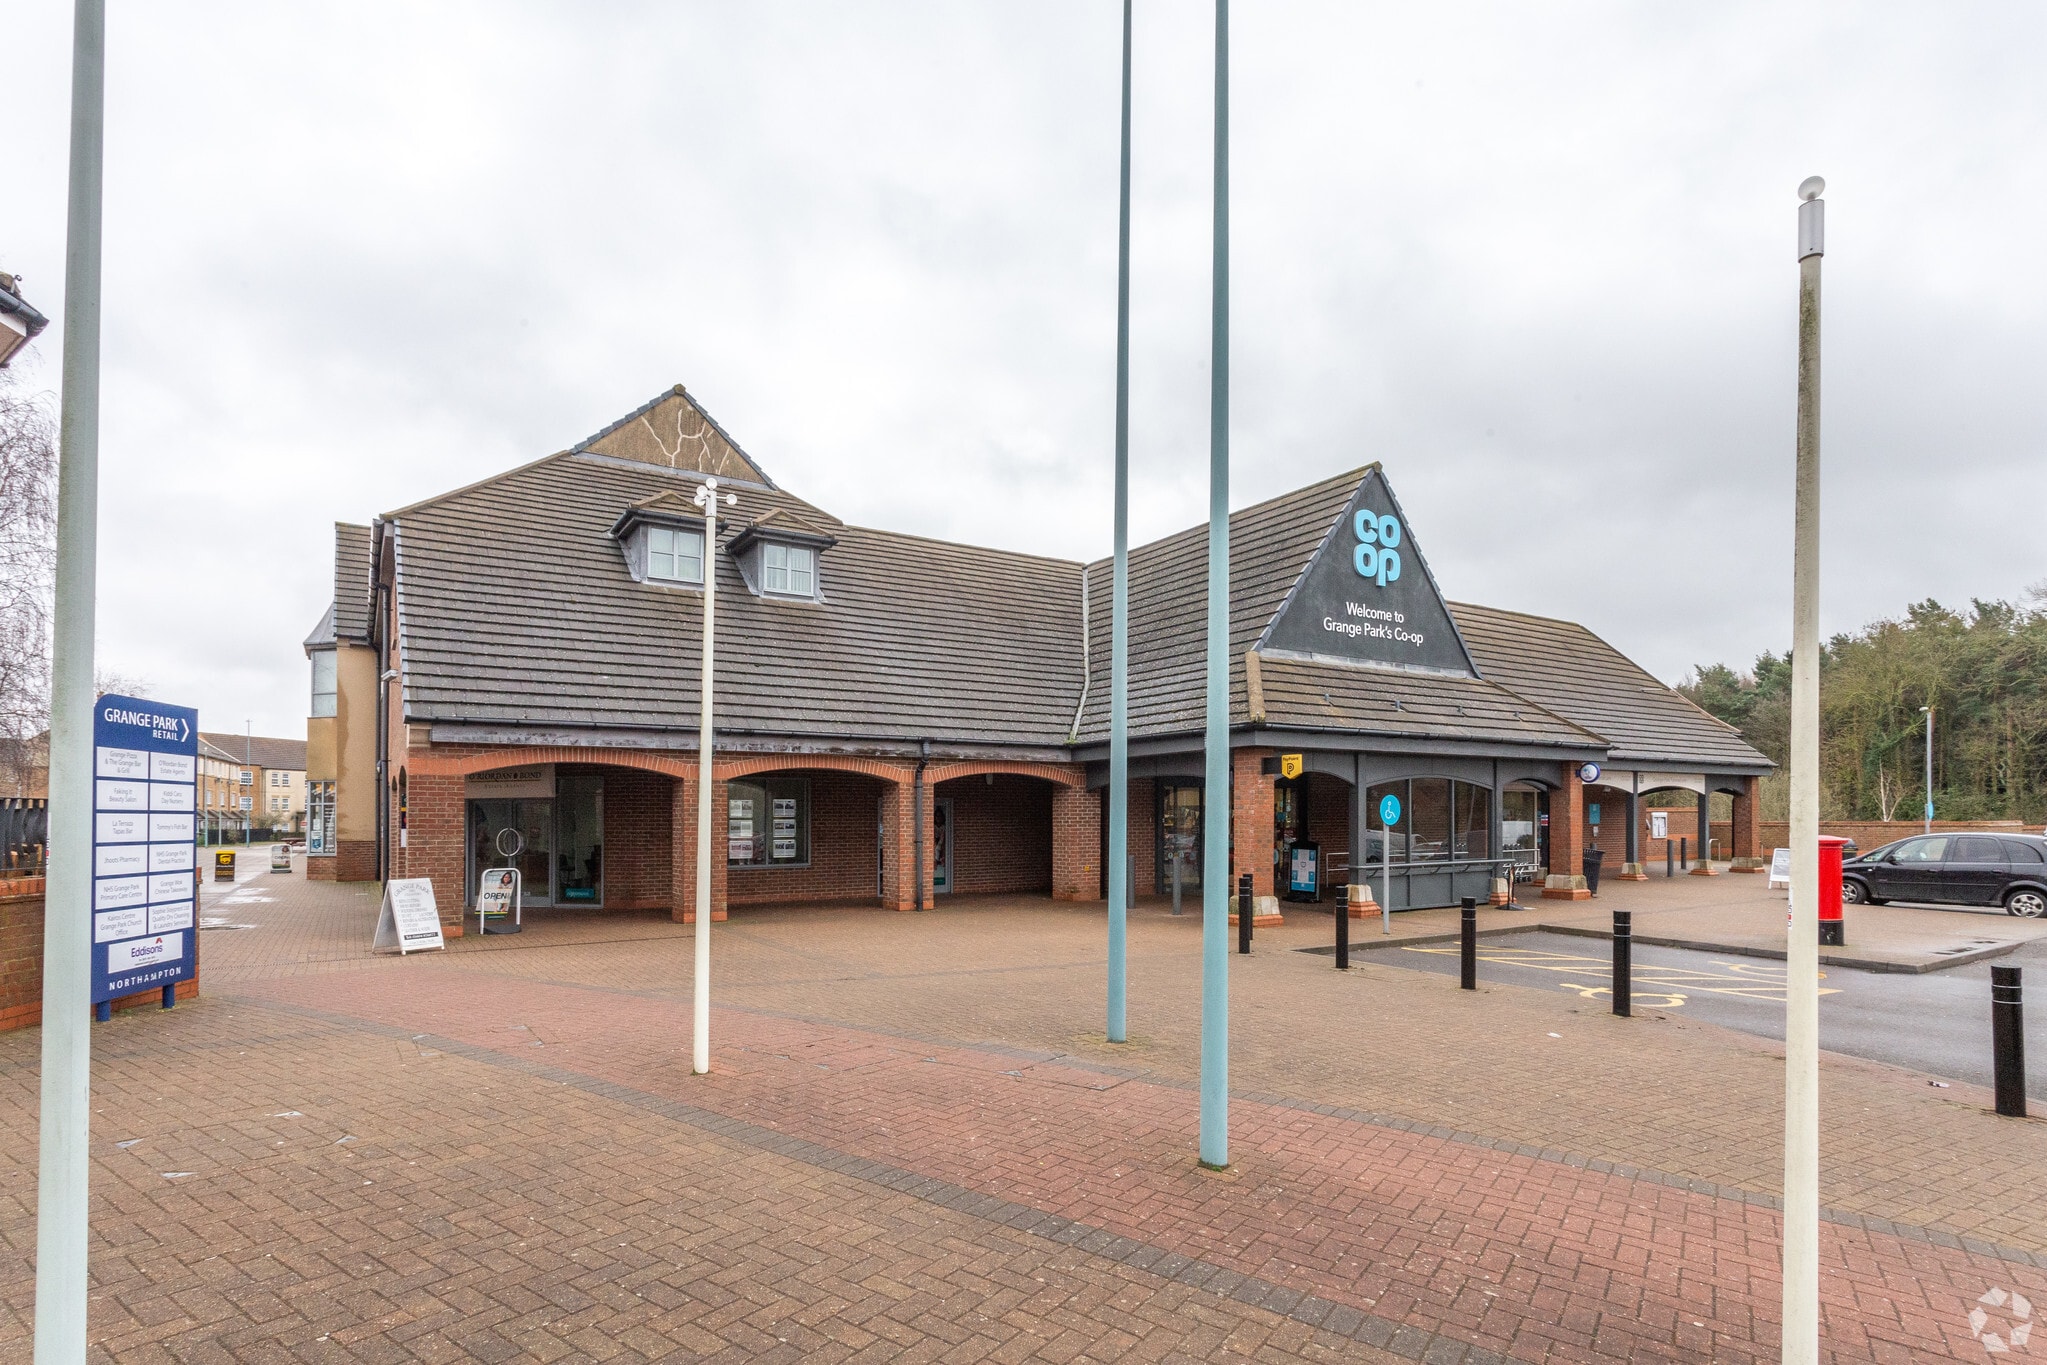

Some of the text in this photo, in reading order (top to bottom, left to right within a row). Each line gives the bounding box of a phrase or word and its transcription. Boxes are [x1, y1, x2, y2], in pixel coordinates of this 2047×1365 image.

[1346, 602, 1404, 623] Welcome to
[1323, 617, 1424, 647] Grange Park's Co-op
[104, 708, 178, 731] GRANGE PARK
[152, 730, 178, 740] RETAIL
[110, 751, 126, 759] Grange
[131, 944, 163, 957] Eddisons
[109, 966, 181, 991] NORTHAMPTON
